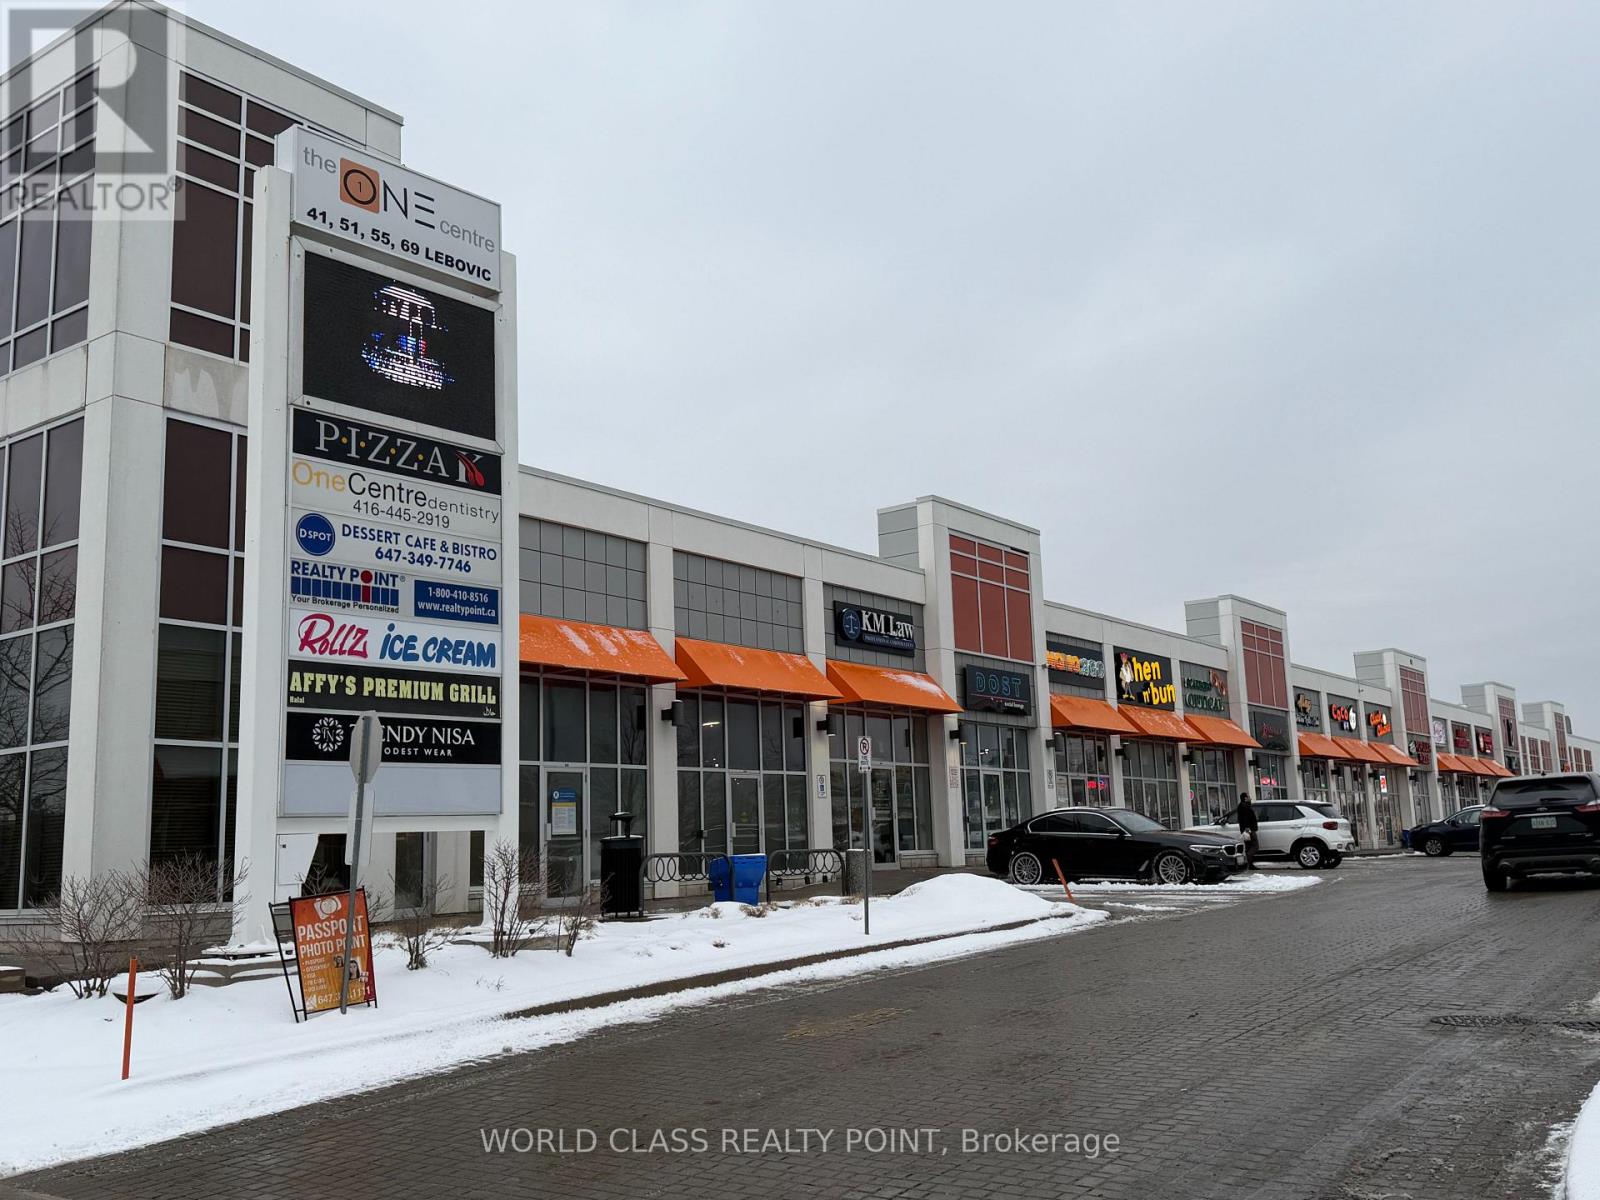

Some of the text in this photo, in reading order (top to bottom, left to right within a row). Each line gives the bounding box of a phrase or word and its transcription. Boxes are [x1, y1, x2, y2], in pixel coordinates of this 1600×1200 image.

[303, 147, 337, 174] the
[343, 168, 436, 230] ONE
[306, 207, 492, 282] 41, 51, 55, 69 LEBOVIC
[439, 220, 495, 252] centre
[353, 500, 450, 528] 416-445-2919
[342, 524, 497, 560] DESSERT CAFE & BISTRO
[291, 560, 347, 580] REALTY
[375, 546, 472, 572] 647-349-7746
[291, 594, 400, 613] Your Brokerage Personalized
[428, 586, 489, 603] 1-800-410-8516
[418, 601, 496, 616] www.realtypoint.ca
[860, 610, 914, 640] KM Law
[422, 636, 496, 668] CREAM
[1132, 656, 1161, 682] hen
[290, 672, 497, 704] AFFY'S PREMIUM GRILL
[976, 671, 1021, 697] DOST
[1150, 682, 1176, 705] bun
[432, 727, 476, 746] NISA
[424, 748, 453, 757] WEAR
[300, 940, 334, 959] PHOTO
